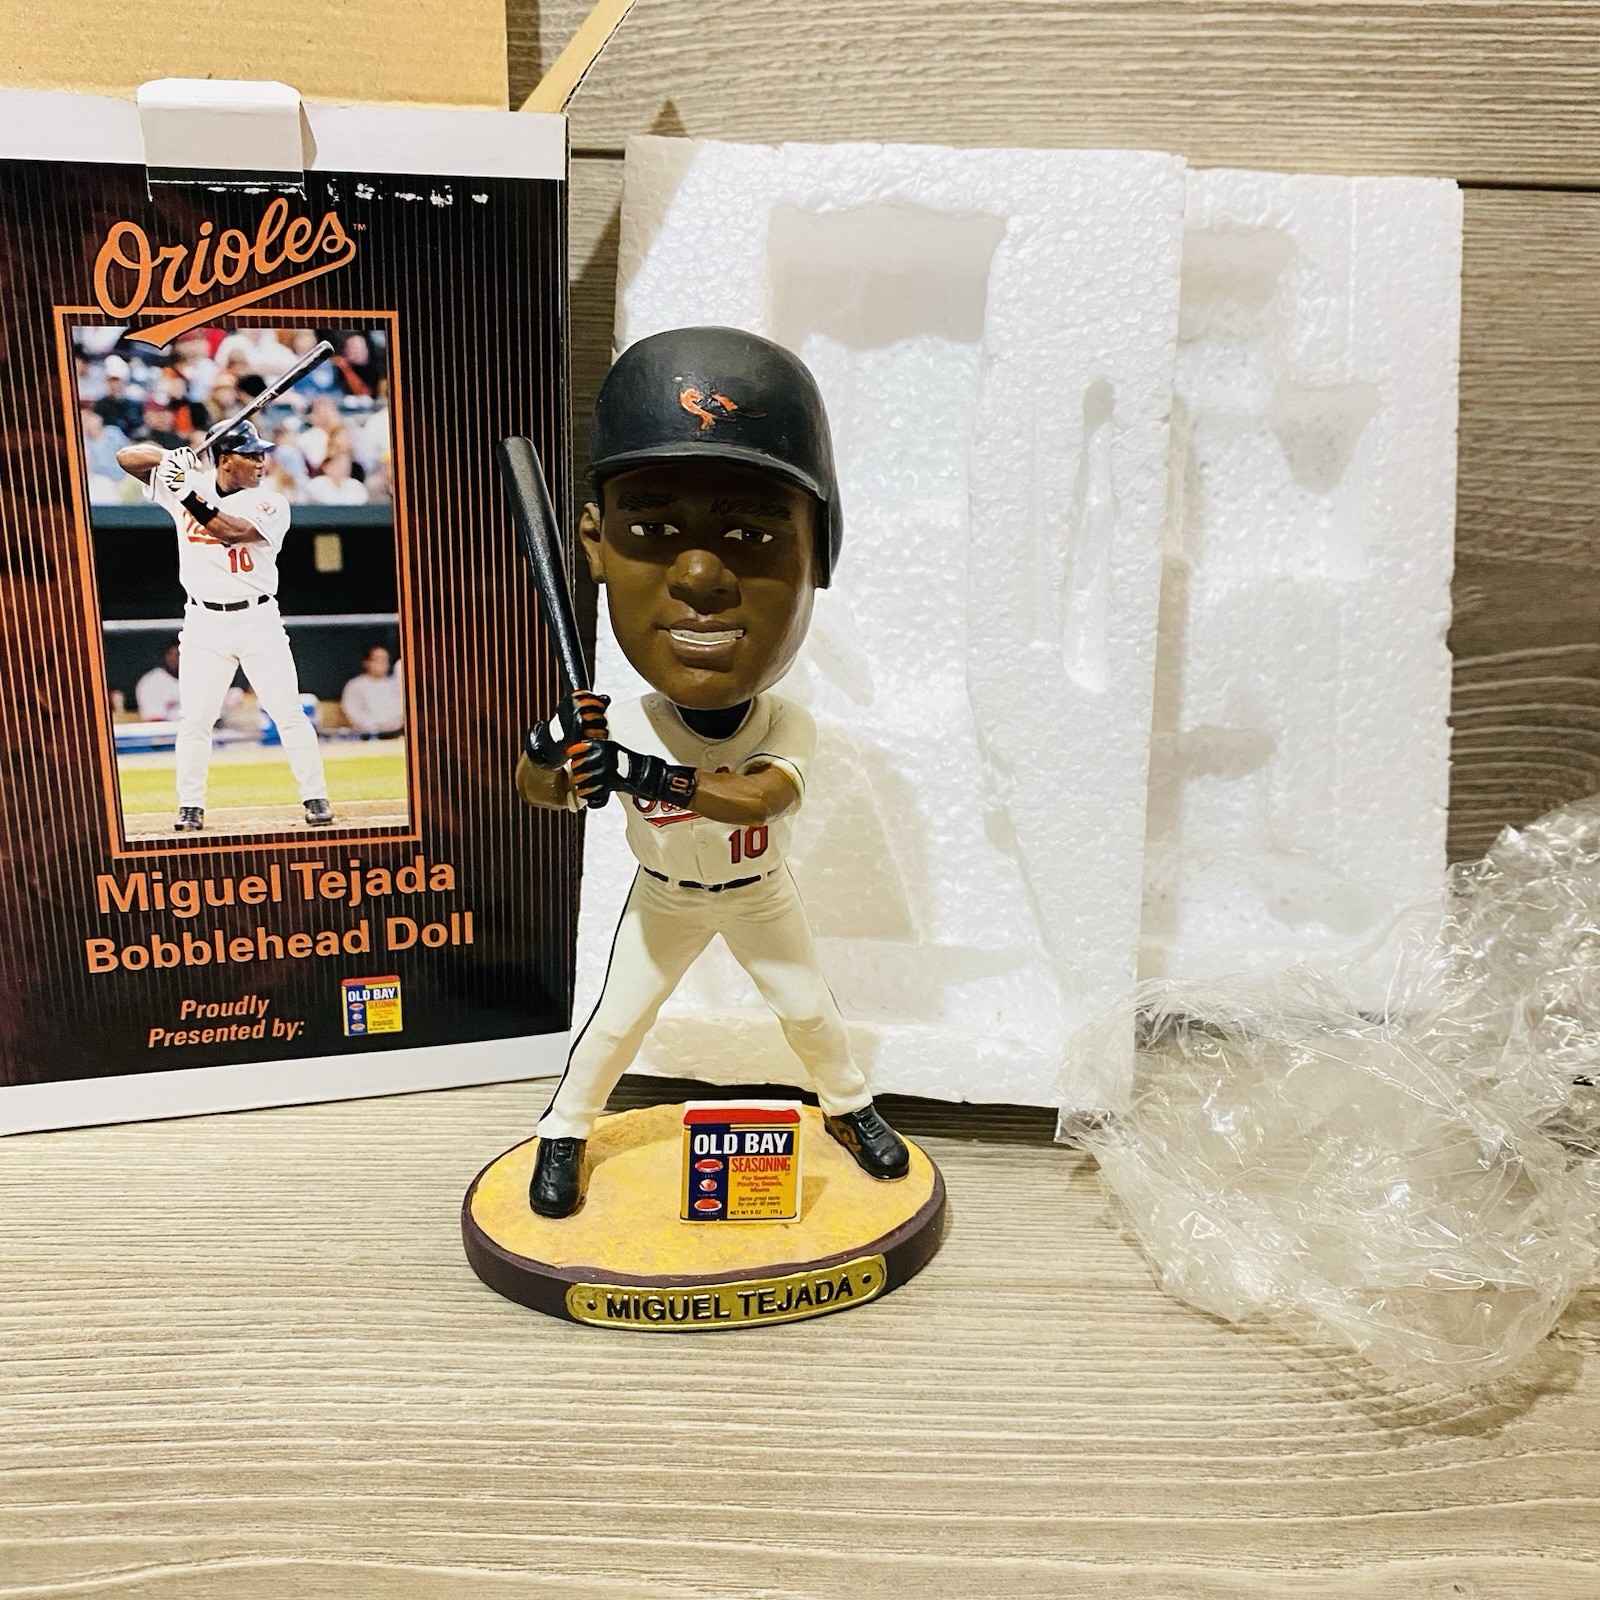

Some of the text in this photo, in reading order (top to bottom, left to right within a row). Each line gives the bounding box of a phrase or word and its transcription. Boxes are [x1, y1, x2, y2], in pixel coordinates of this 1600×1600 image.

[94, 197, 356, 318] Orioles
[228, 547, 255, 574] 10
[728, 825, 769, 864] 10
[96, 855, 456, 919] Miguel Tejada
[85, 911, 475, 974] Bobblehead Doll
[180, 995, 270, 1020] Proudly
[348, 988, 395, 1002] OLD BAY
[148, 1018, 305, 1048] Presented by:
[693, 1132, 788, 1155] OLD BAY
[731, 1156, 791, 1173] SEASONING
[606, 1274, 853, 1320] MIGUEL TEJADA
